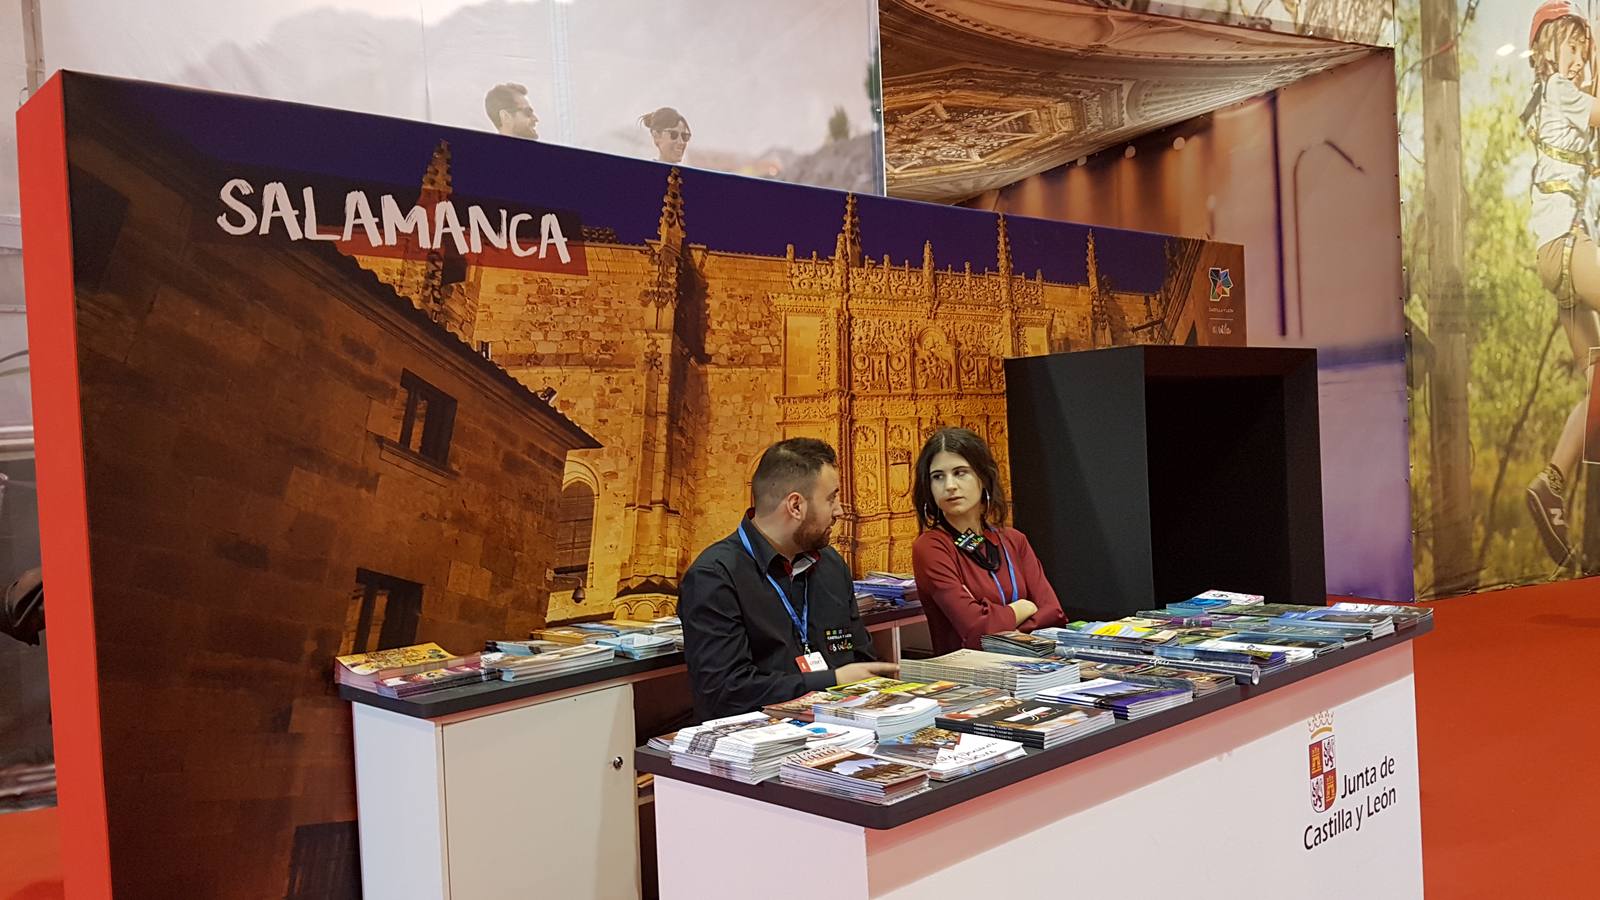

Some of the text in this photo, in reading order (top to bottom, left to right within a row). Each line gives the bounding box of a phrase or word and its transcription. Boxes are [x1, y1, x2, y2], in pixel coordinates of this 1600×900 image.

[216, 178, 571, 264] SALAMANCA
[1341, 756, 1395, 799] Junta de
[1303, 787, 1396, 850] Castilla y León
